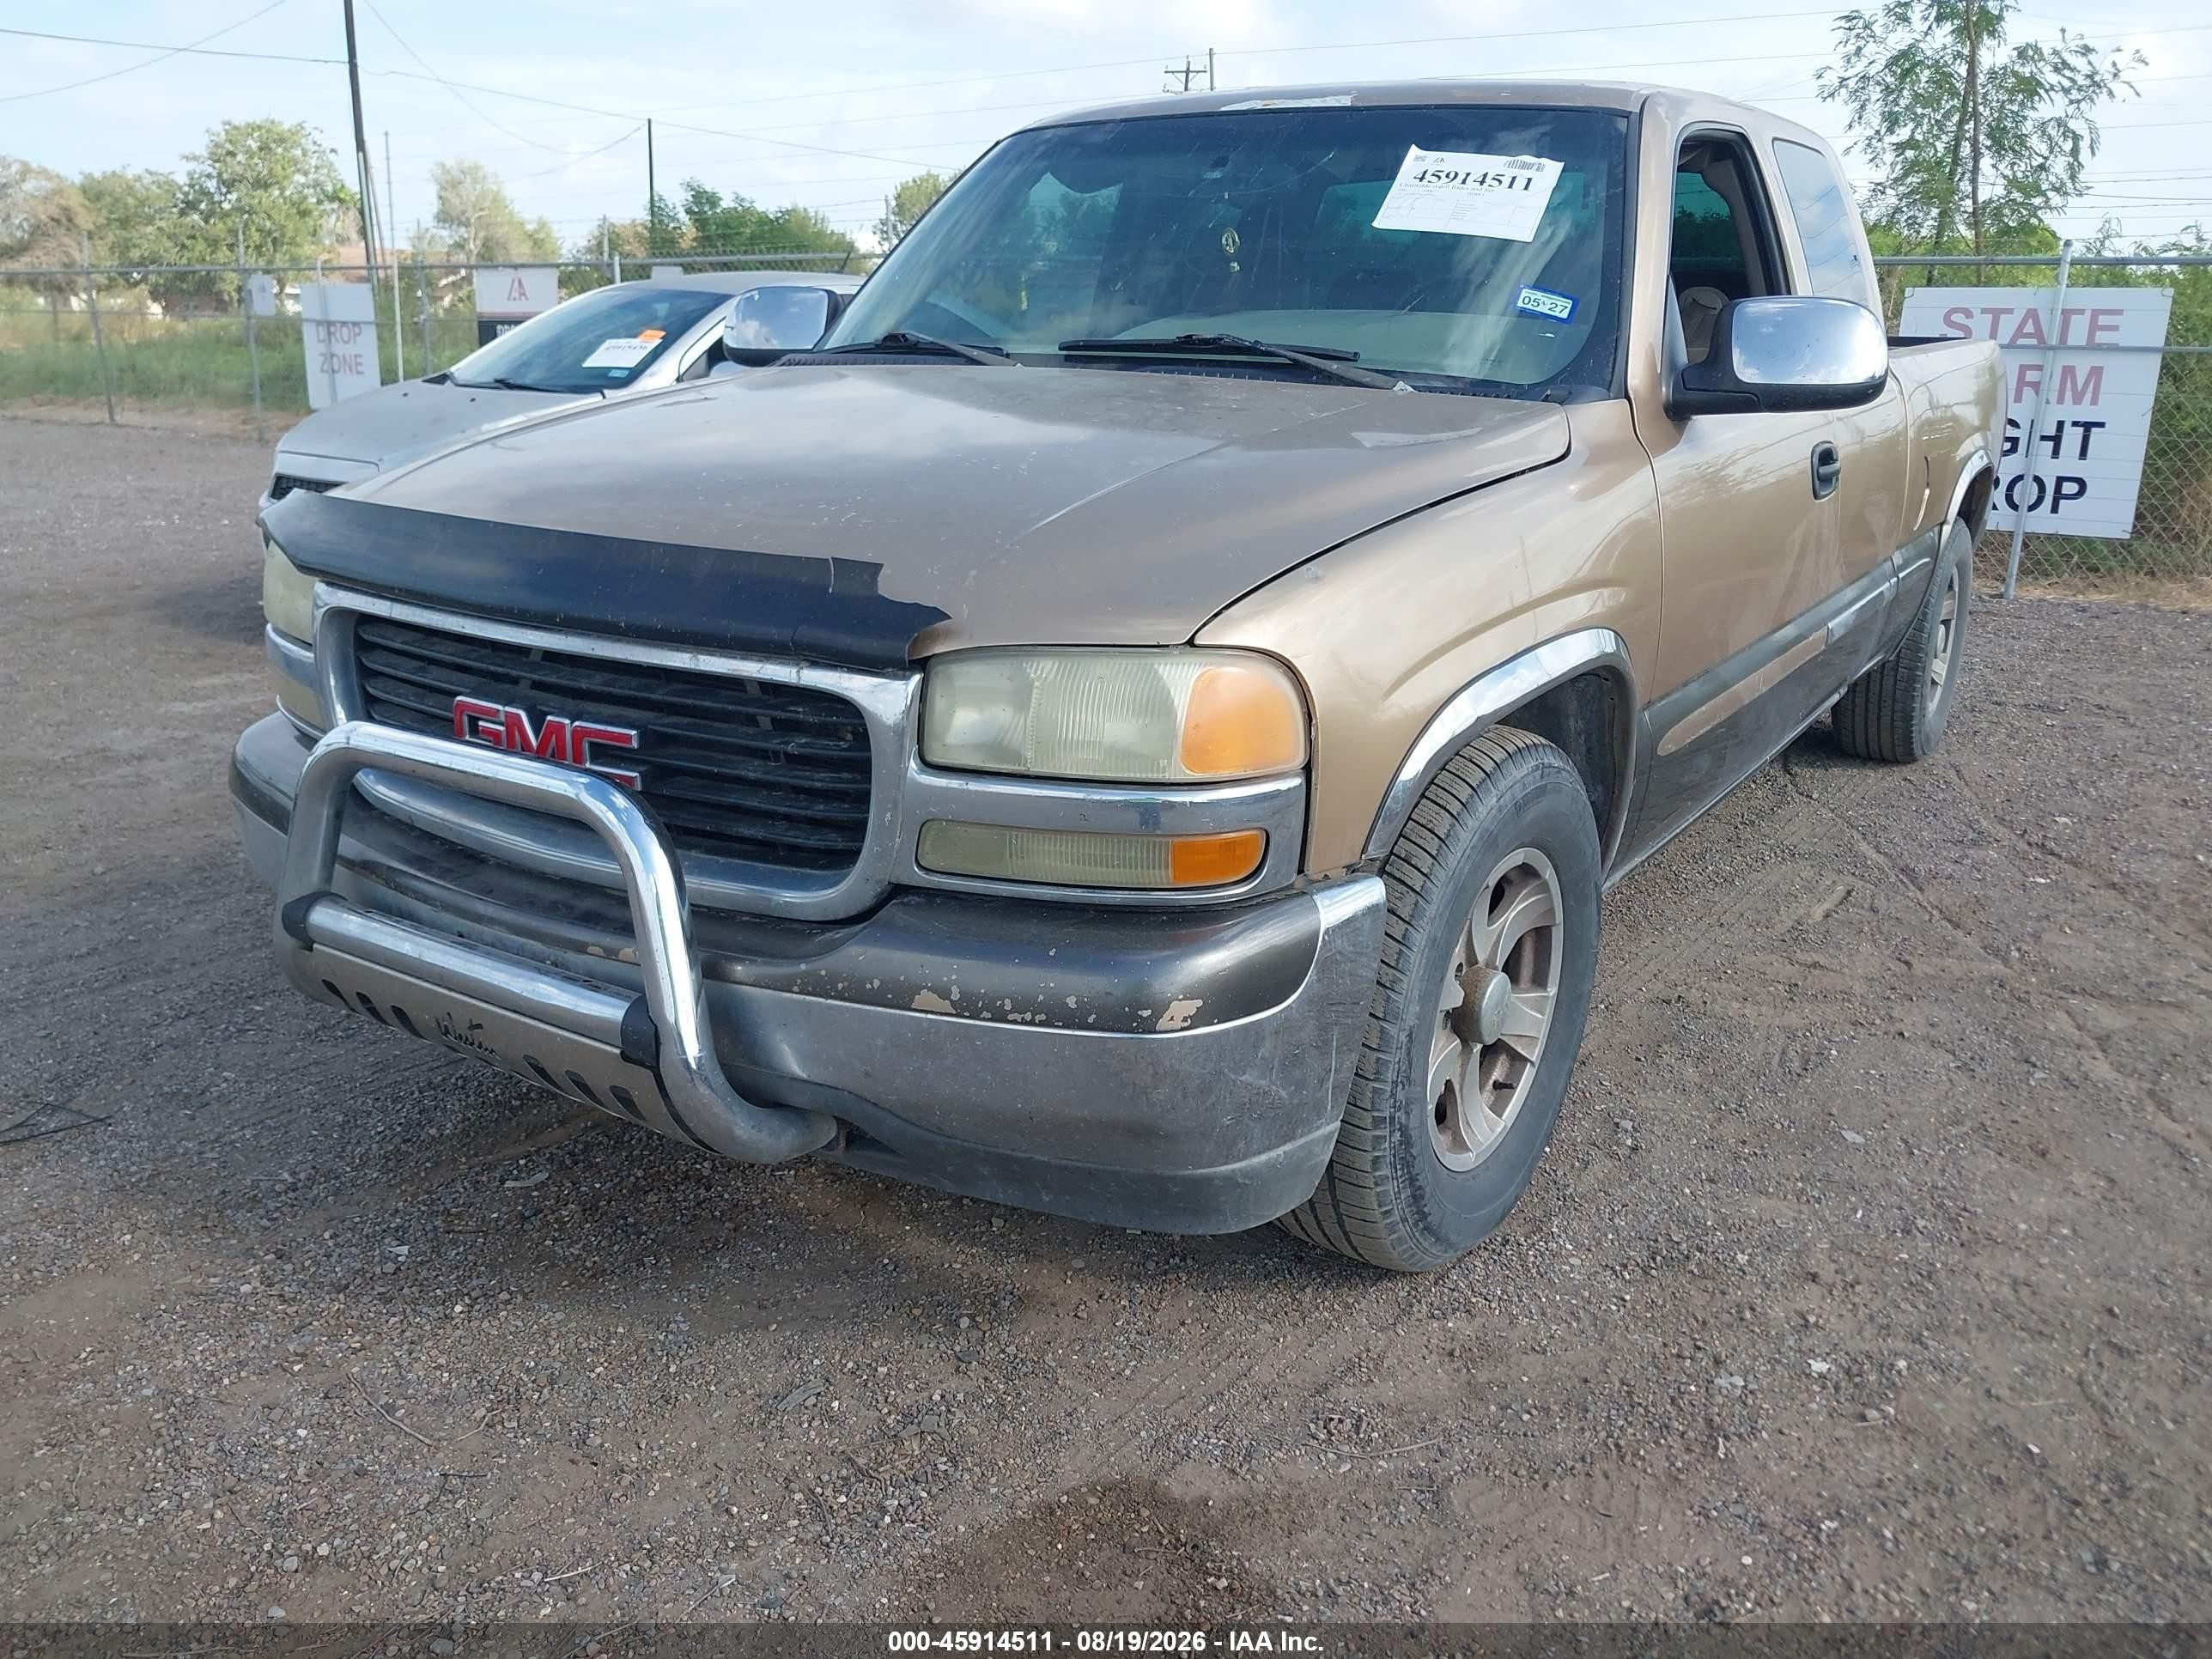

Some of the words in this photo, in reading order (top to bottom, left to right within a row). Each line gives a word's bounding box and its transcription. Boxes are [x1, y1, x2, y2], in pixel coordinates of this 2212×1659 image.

[1413, 168, 1534, 191] 45914511
[1522, 295, 1541, 307] 05
[1547, 302, 1569, 314] 27
[316, 321, 362, 344] DROP
[1940, 307, 2124, 348] STATE
[319, 353, 364, 374] ZONE
[2013, 363, 2105, 406] RM
[2001, 417, 2106, 460] GHT
[1992, 473, 2087, 514] OP
[453, 696, 642, 791] GMC
